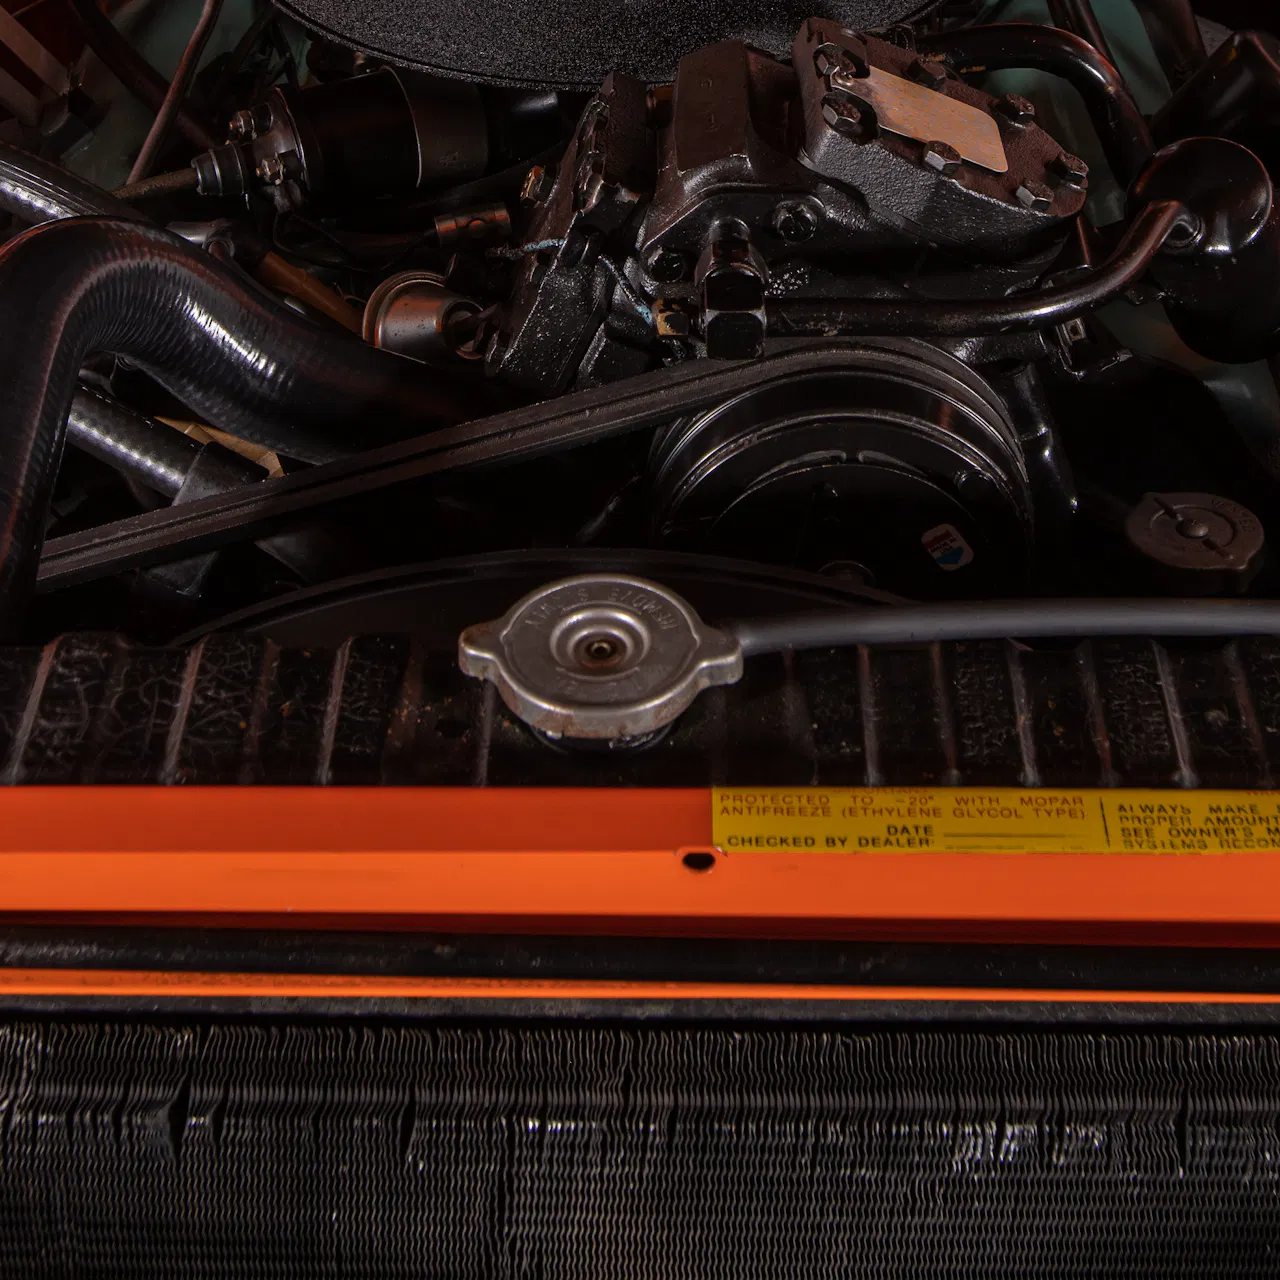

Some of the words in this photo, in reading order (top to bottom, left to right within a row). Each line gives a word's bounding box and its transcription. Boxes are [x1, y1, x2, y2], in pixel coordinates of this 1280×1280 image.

[721, 796, 830, 805] PROTECTED
[853, 797, 874, 805] TO
[955, 797, 999, 806] WITH
[1020, 797, 1084, 806] MOPAR
[720, 808, 831, 817] ANTIFREEZE
[842, 808, 942, 818] (ETHYLENE
[953, 808, 1023, 818] GLYCOL
[1033, 808, 1086, 819] TYPE)
[1209, 804, 1259, 814] MAKE
[1204, 815, 1279, 825] AMOUNT
[887, 824, 934, 836] DATE
[1121, 827, 1154, 838] SEE
[1169, 827, 1253, 838] OWNER'S
[728, 836, 815, 847] CHECKED
[826, 837, 848, 848] BY
